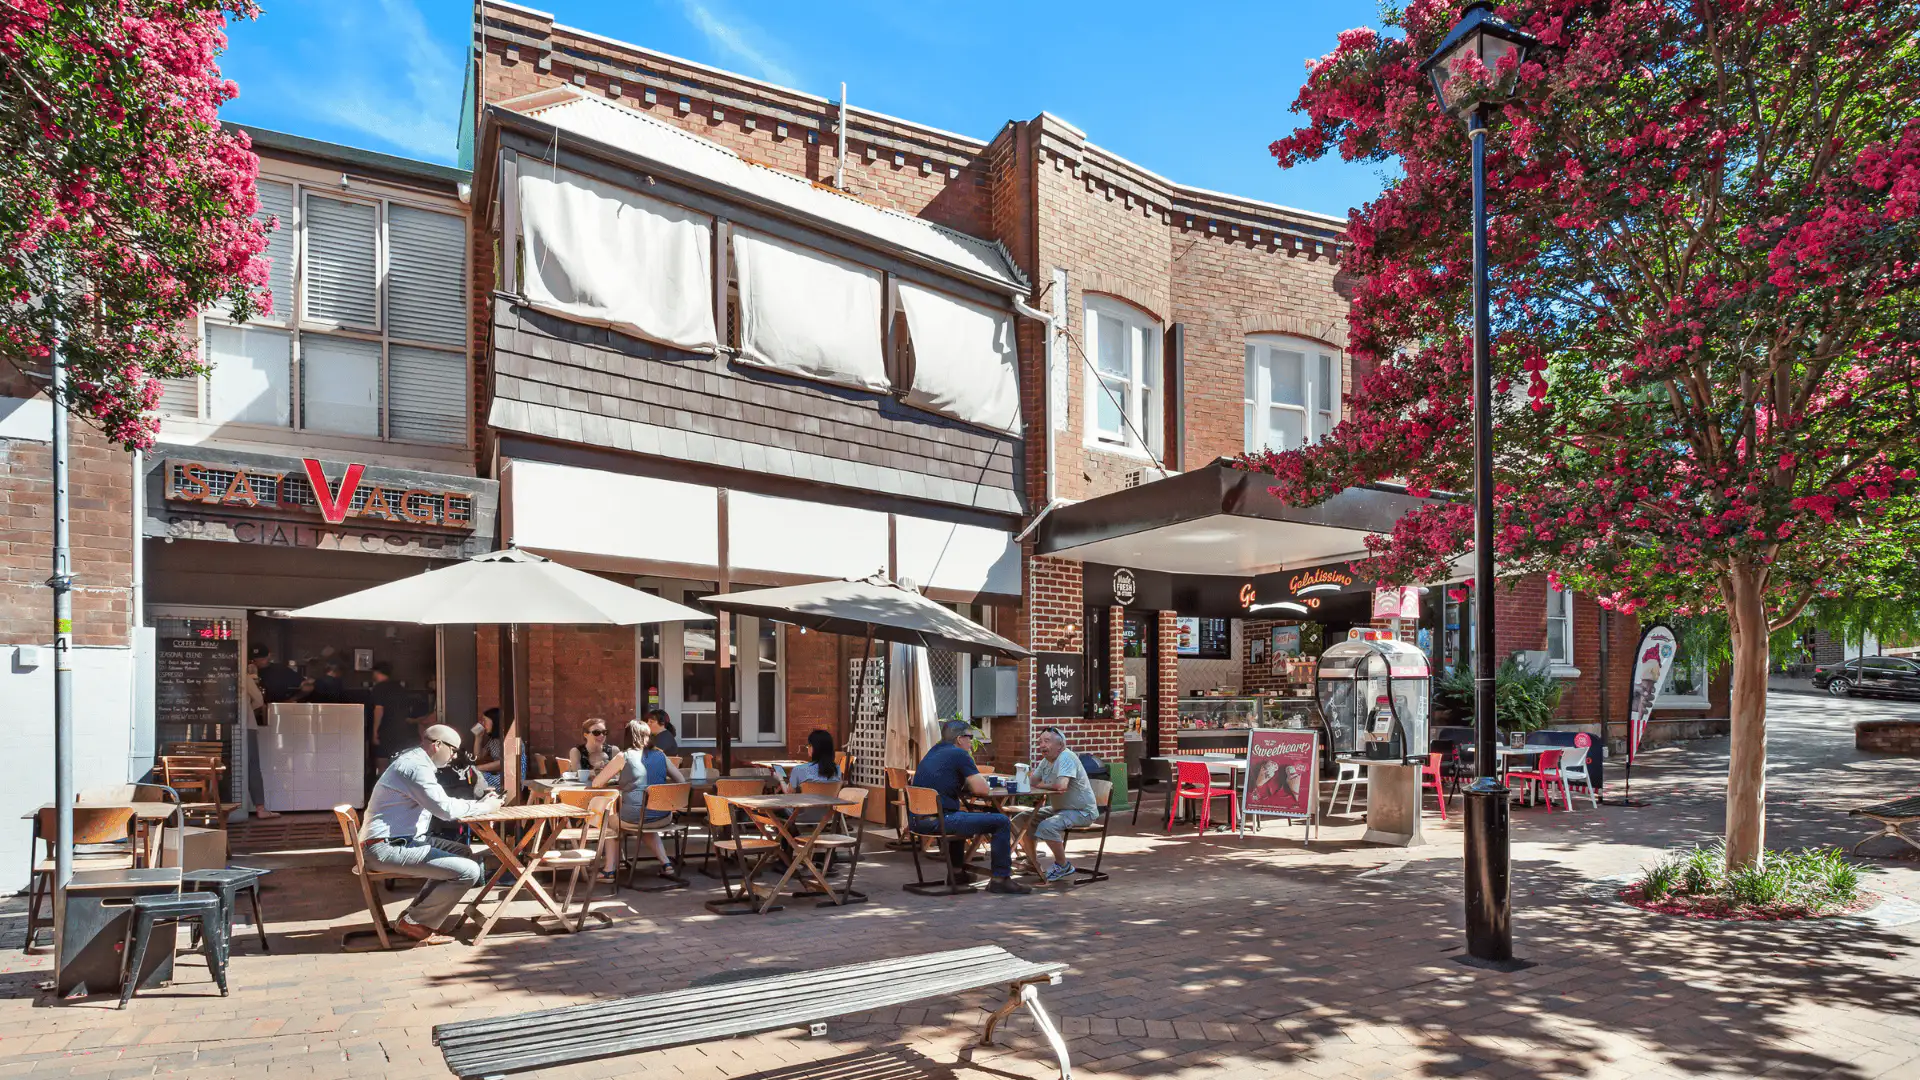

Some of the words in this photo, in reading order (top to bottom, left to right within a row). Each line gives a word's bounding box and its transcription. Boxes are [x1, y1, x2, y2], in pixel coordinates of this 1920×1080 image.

[181, 458, 472, 525] SALVAGE
[166, 516, 348, 550] SPECIALTY
[359, 532, 476, 559] COFFEE
[1116, 583, 1133, 592] FRESH
[1289, 568, 1352, 595] Gelatissimo
[55, 637, 68, 653] 4
[1252, 742, 1310, 758] Sweetheart?
